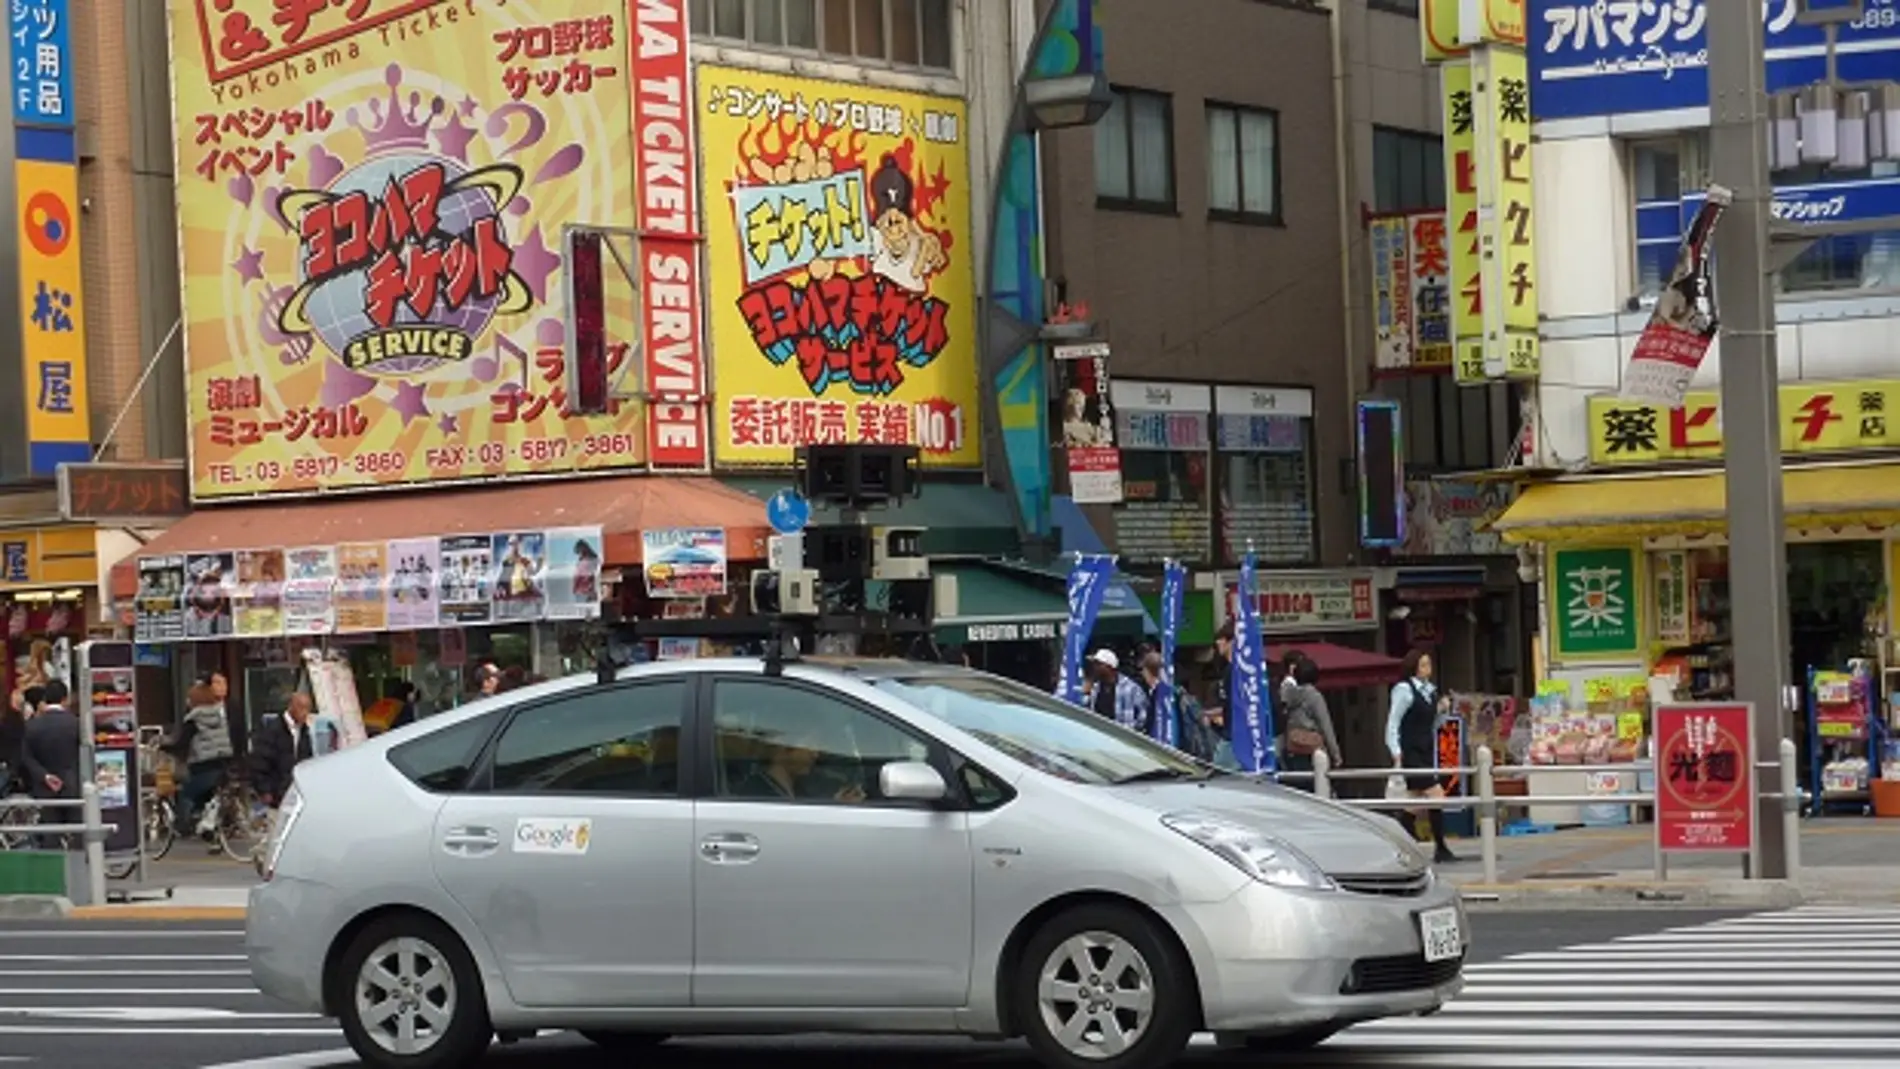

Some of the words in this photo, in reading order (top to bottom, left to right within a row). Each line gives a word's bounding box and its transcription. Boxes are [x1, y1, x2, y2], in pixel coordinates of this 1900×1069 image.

[211, 42, 361, 104] Yokohama
[377, 0, 477, 47] Ticket
[493, 15, 615, 63] プロ野球
[502, 60, 618, 99] サッカー
[195, 100, 334, 145] スペシャル
[728, 86, 809, 121] コンサート
[832, 102, 903, 135] プロ野球
[196, 140, 297, 182] イベント
[639, 76, 687, 234] TICKET
[301, 162, 446, 279] ヨコハマ
[745, 177, 864, 268] チケット!
[366, 218, 513, 329] チケット
[737, 275, 949, 358] ヨコハマチケット
[31, 280, 74, 413] 松屋
[347, 330, 466, 368] SERVICE
[649, 252, 698, 448] SERVICE
[796, 333, 904, 394] サービス
[207, 375, 261, 411] 演劇
[1859, 391, 1886, 439] 薬店
[209, 404, 369, 447] ミュージカル
[731, 400, 846, 446] 委託販売
[855, 402, 909, 446] 実績
[914, 402, 964, 450] No.1
[1603, 394, 1843, 454] 薬ヒチ
[73, 473, 182, 512] チケット
[517, 822, 574, 849] Google
